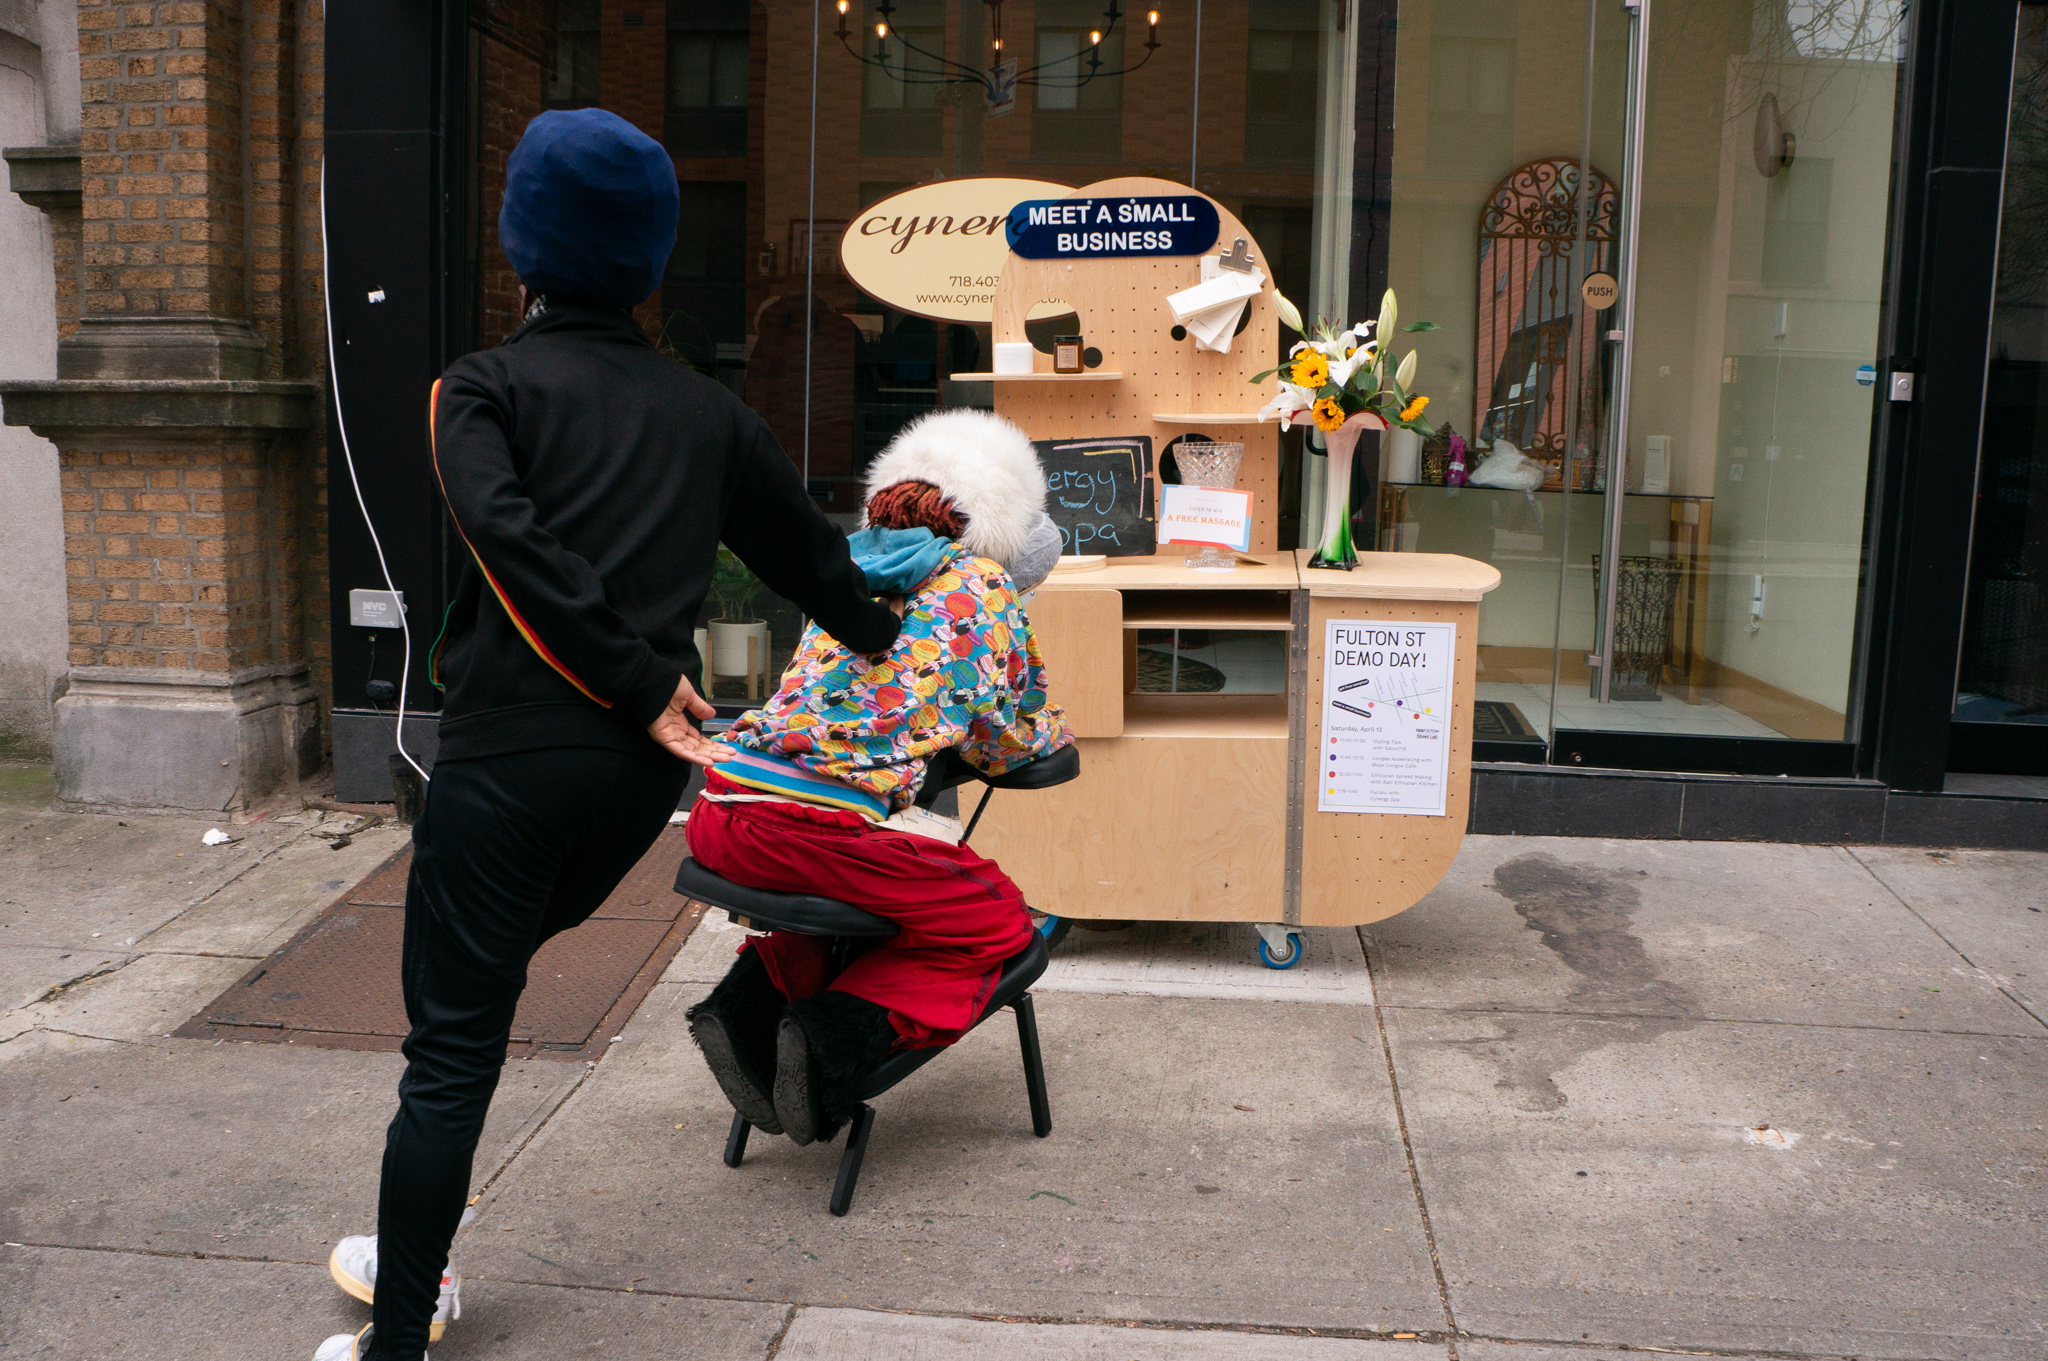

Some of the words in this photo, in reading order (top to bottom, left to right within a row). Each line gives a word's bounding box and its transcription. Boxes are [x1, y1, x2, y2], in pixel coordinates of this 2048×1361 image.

[1029, 205, 1091, 226] MEET
[1096, 204, 1113, 224] A
[1118, 202, 1196, 223] SMALL
[1057, 230, 1173, 252] BUSINESS
[1587, 286, 1613, 297] PUSH
[1167, 514, 1174, 522] A
[1176, 515, 1198, 523] FREE
[1200, 516, 1241, 528] MASSAGE
[362, 601, 387, 611] NYC
[1336, 629, 1399, 646] FULTON
[1405, 631, 1426, 647] ST
[1335, 650, 1383, 667] DEMO
[1390, 652, 1426, 668] DAY!
[1331, 725, 1359, 733] Saturday,
